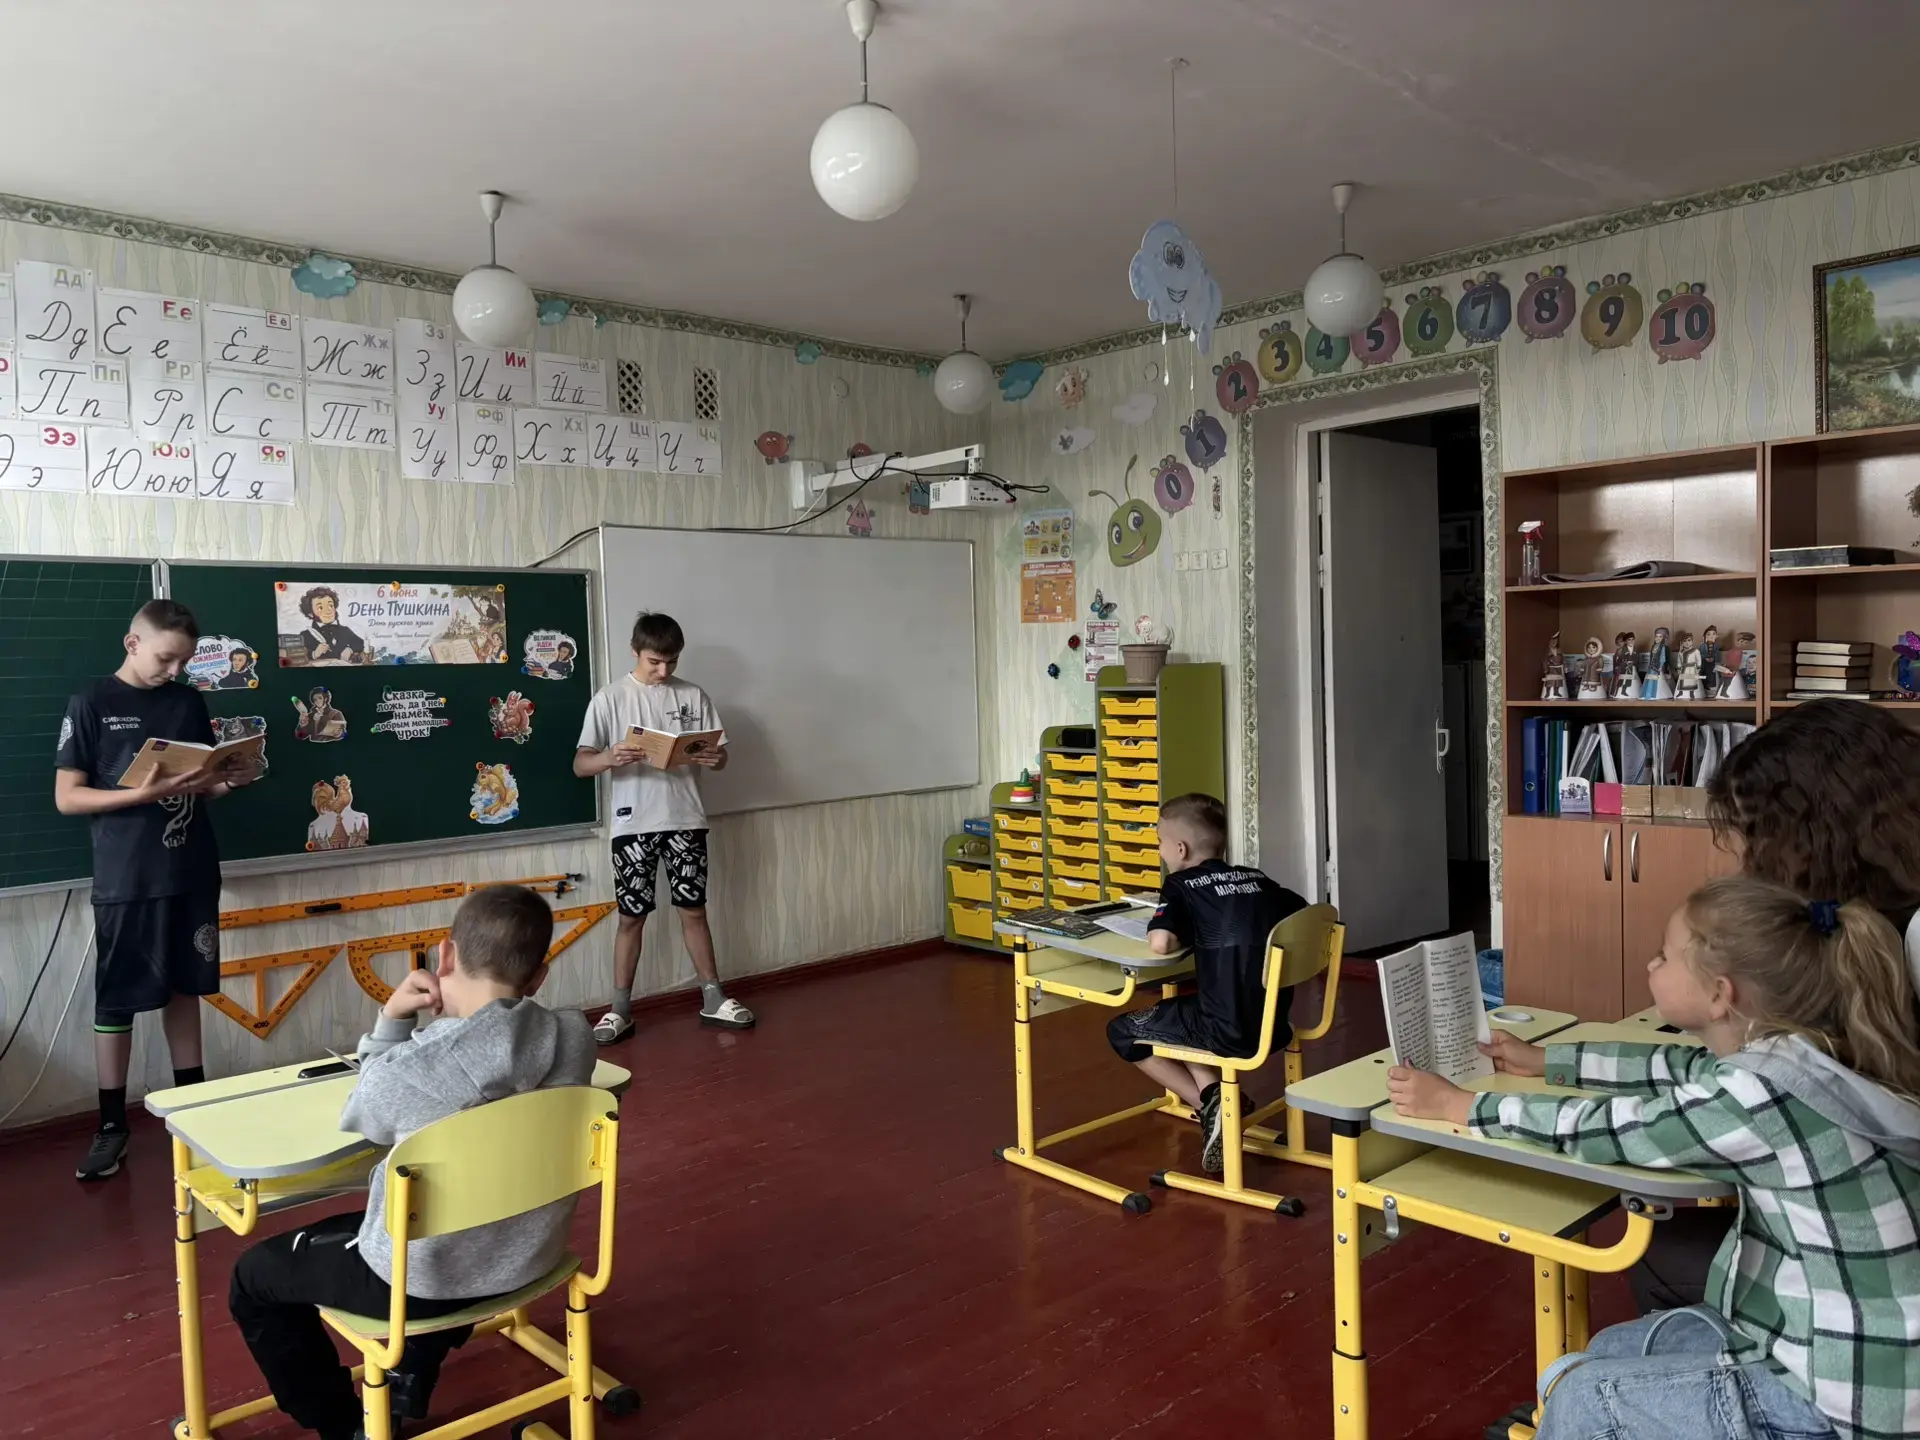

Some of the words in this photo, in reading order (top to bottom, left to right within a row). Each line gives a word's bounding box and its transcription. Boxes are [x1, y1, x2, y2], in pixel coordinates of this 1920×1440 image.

[1470, 293, 1493, 330] 7
[1534, 288, 1559, 324] 8
[1599, 296, 1625, 337] 9
[1366, 317, 1385, 352] 5
[1417, 307, 1439, 341] 6
[1659, 304, 1710, 346] 10
[1271, 340, 1290, 372] 3
[1316, 333, 1333, 360] 4
[1227, 371, 1248, 403] 2
[1196, 428, 1216, 457] 1
[1165, 473, 1182, 500] 0
[377, 585, 385, 598] 6
[390, 588, 418, 598] июня
[377, 702, 406, 712] ложь,
[408, 701, 419, 709] да
[383, 689, 425, 702] Сказка
[375, 721, 410, 733] добрым
[394, 709, 432, 720] намёк,
[397, 728, 430, 740] урок!
